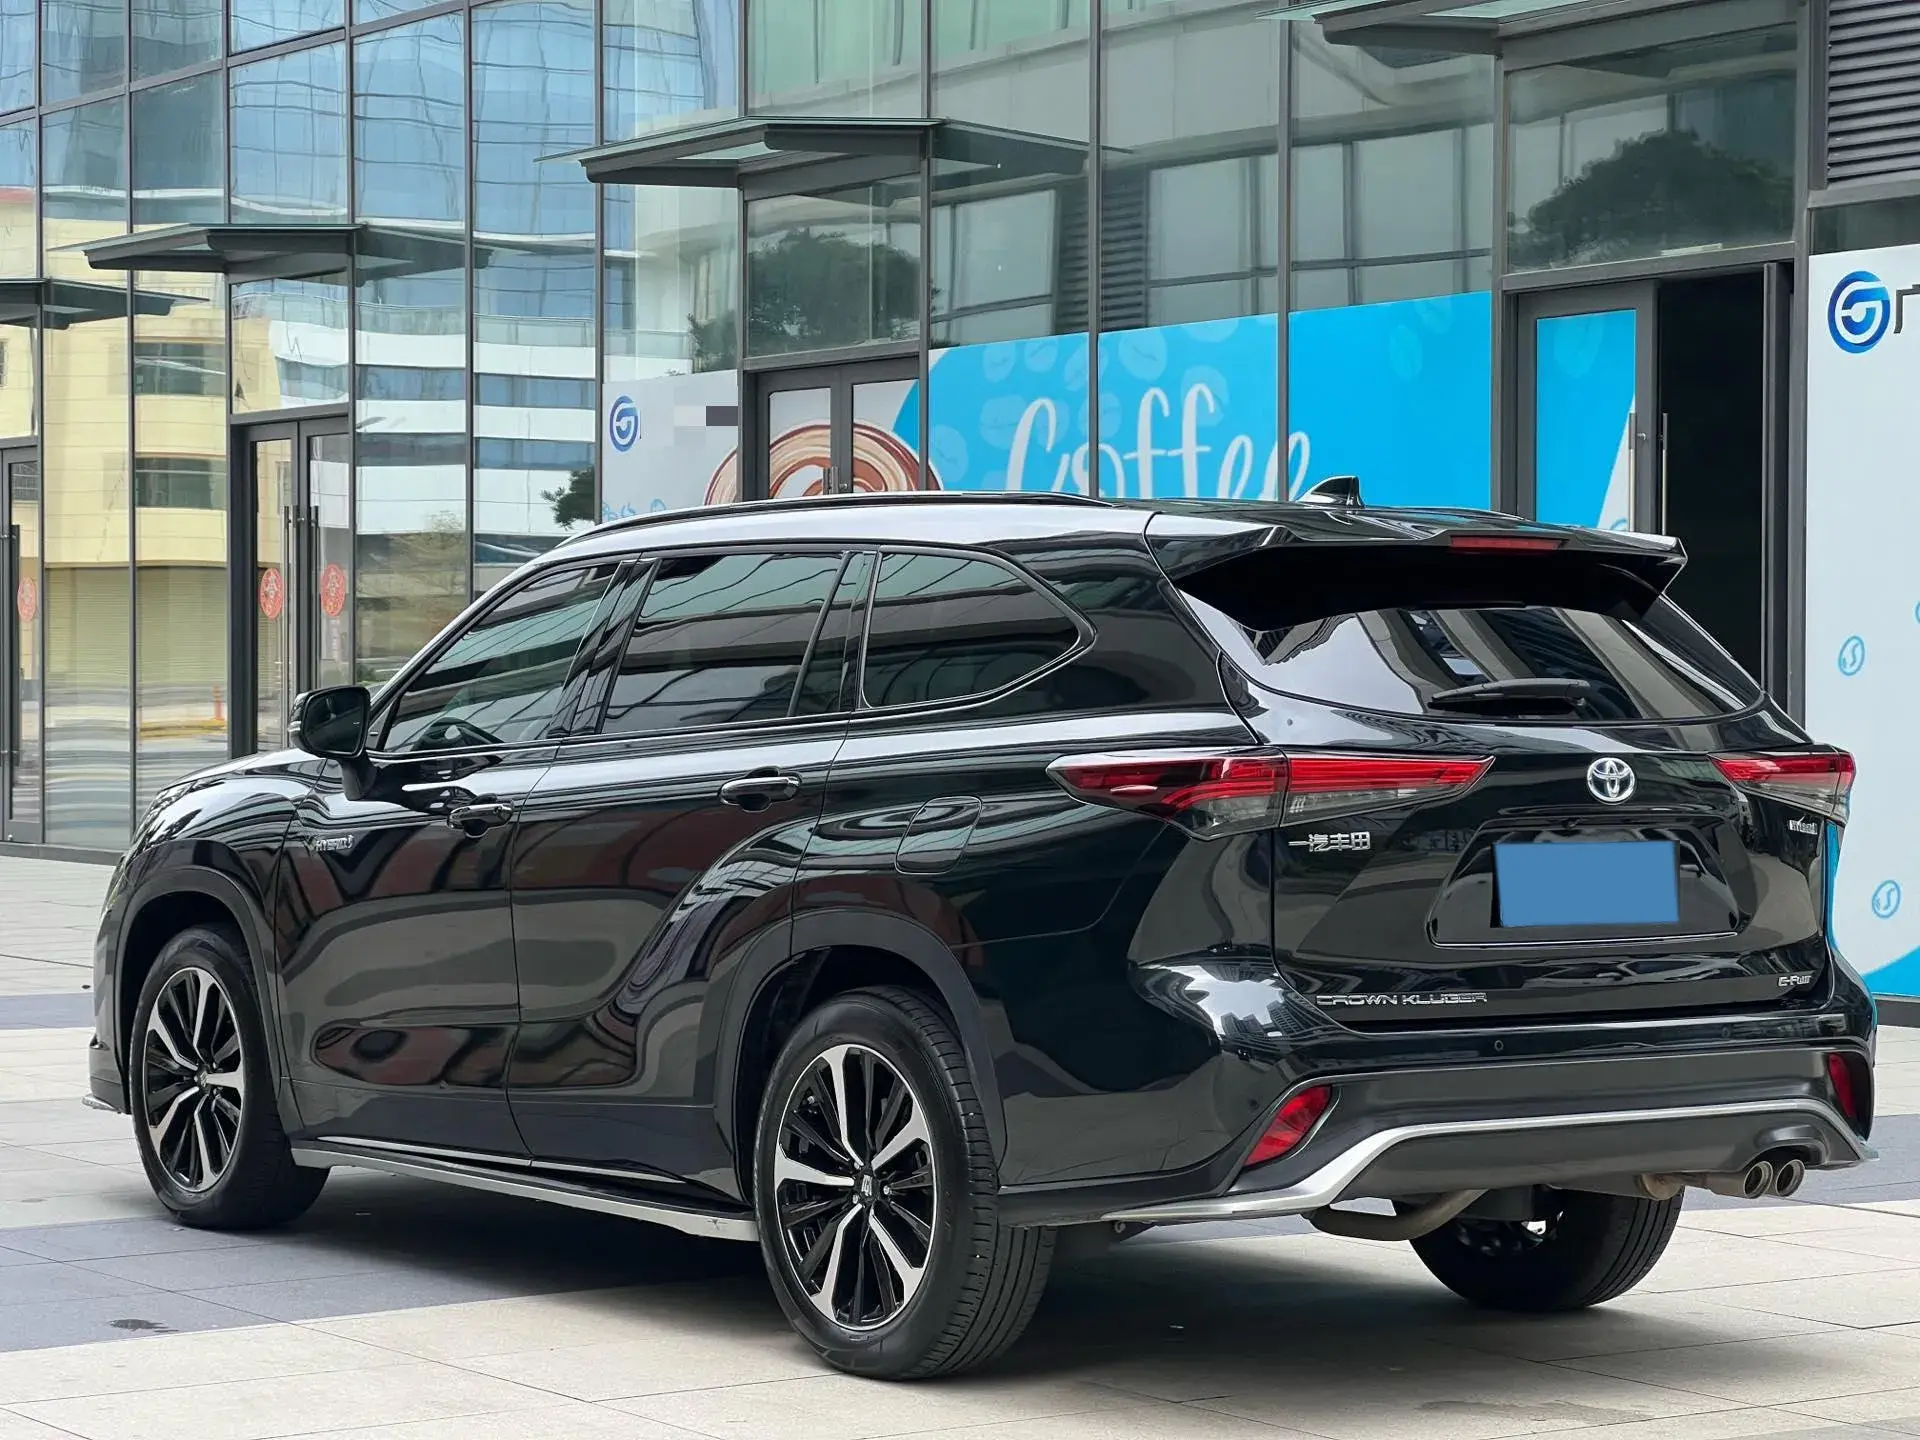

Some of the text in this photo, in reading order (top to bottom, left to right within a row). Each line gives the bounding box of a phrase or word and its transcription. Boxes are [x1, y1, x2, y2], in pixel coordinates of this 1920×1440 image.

[1288, 831, 1371, 852] 一汽丰田
[1316, 994, 1398, 1005] CROWN
